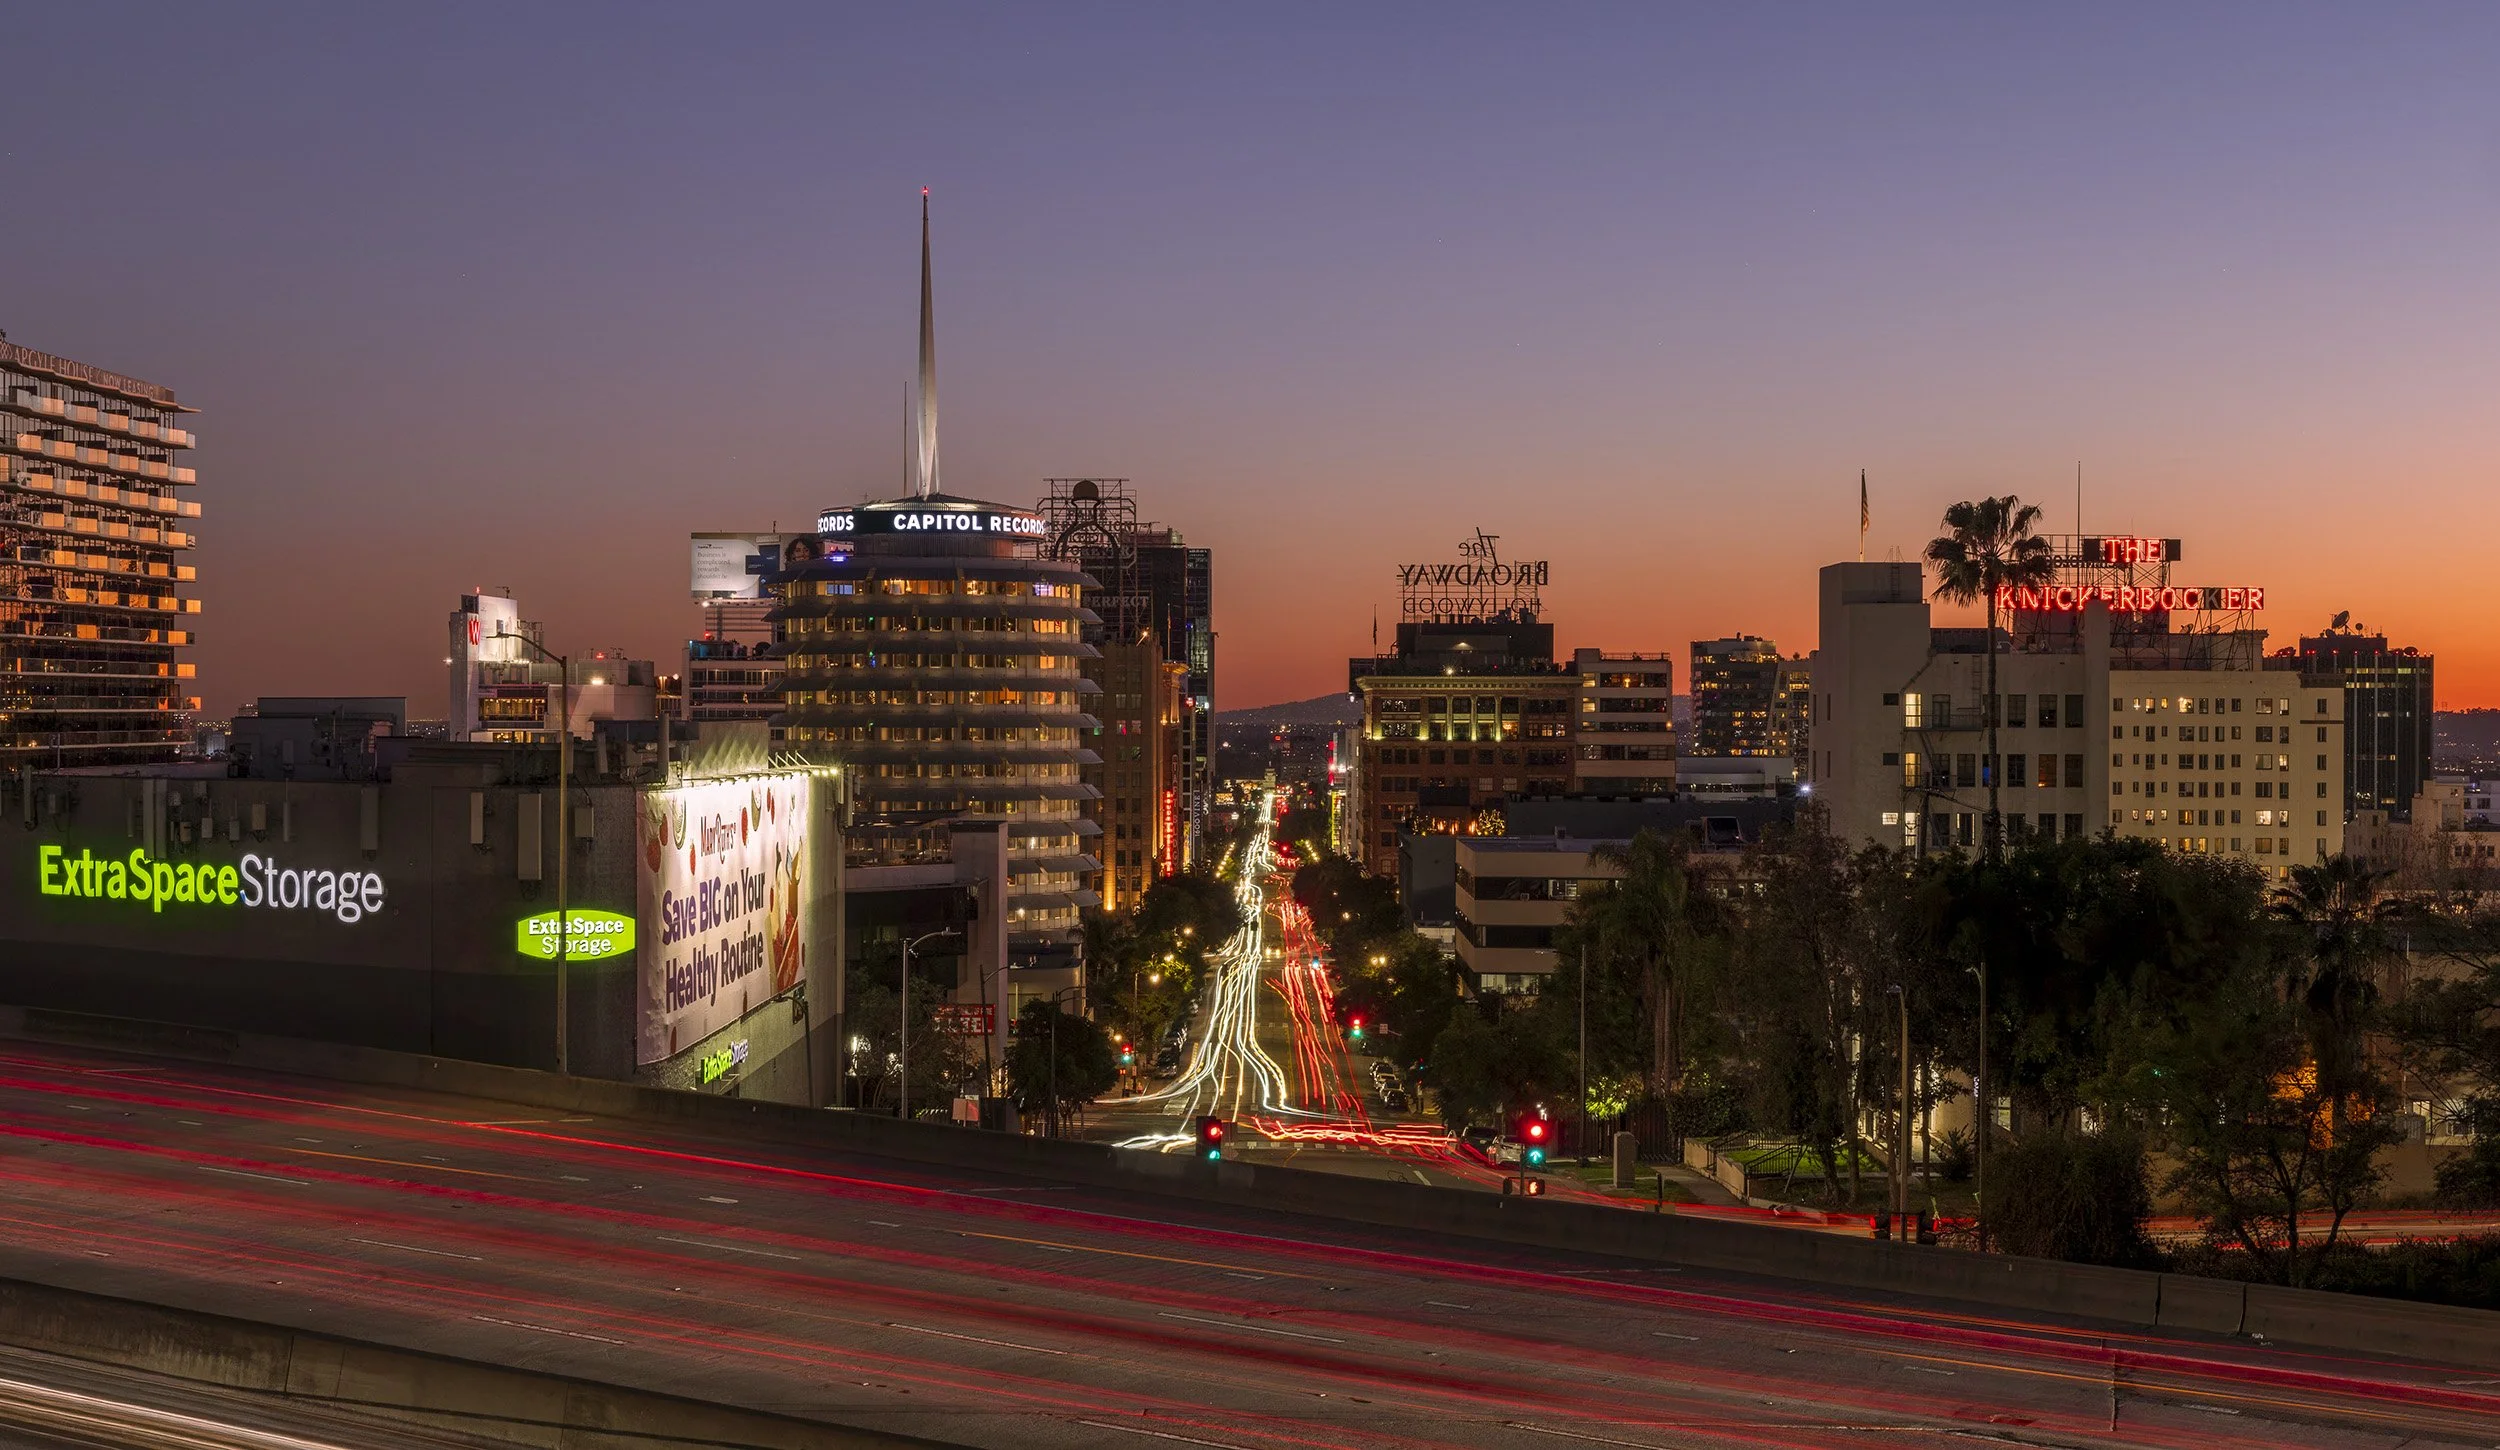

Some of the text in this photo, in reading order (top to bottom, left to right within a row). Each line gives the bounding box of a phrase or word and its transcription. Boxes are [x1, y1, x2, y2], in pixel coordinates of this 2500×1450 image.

[15, 347, 154, 398] ARGYLE HOUSE NOW LEASING
[893, 514, 983, 531] CAPITOL
[990, 516, 1045, 535] RECORDS
[2105, 538, 2161, 563] THE
[1998, 586, 2264, 611] KNICKERBOCKER
[662, 867, 766, 946] Save BIG on Your
[665, 919, 764, 1014] Healthy Routine
